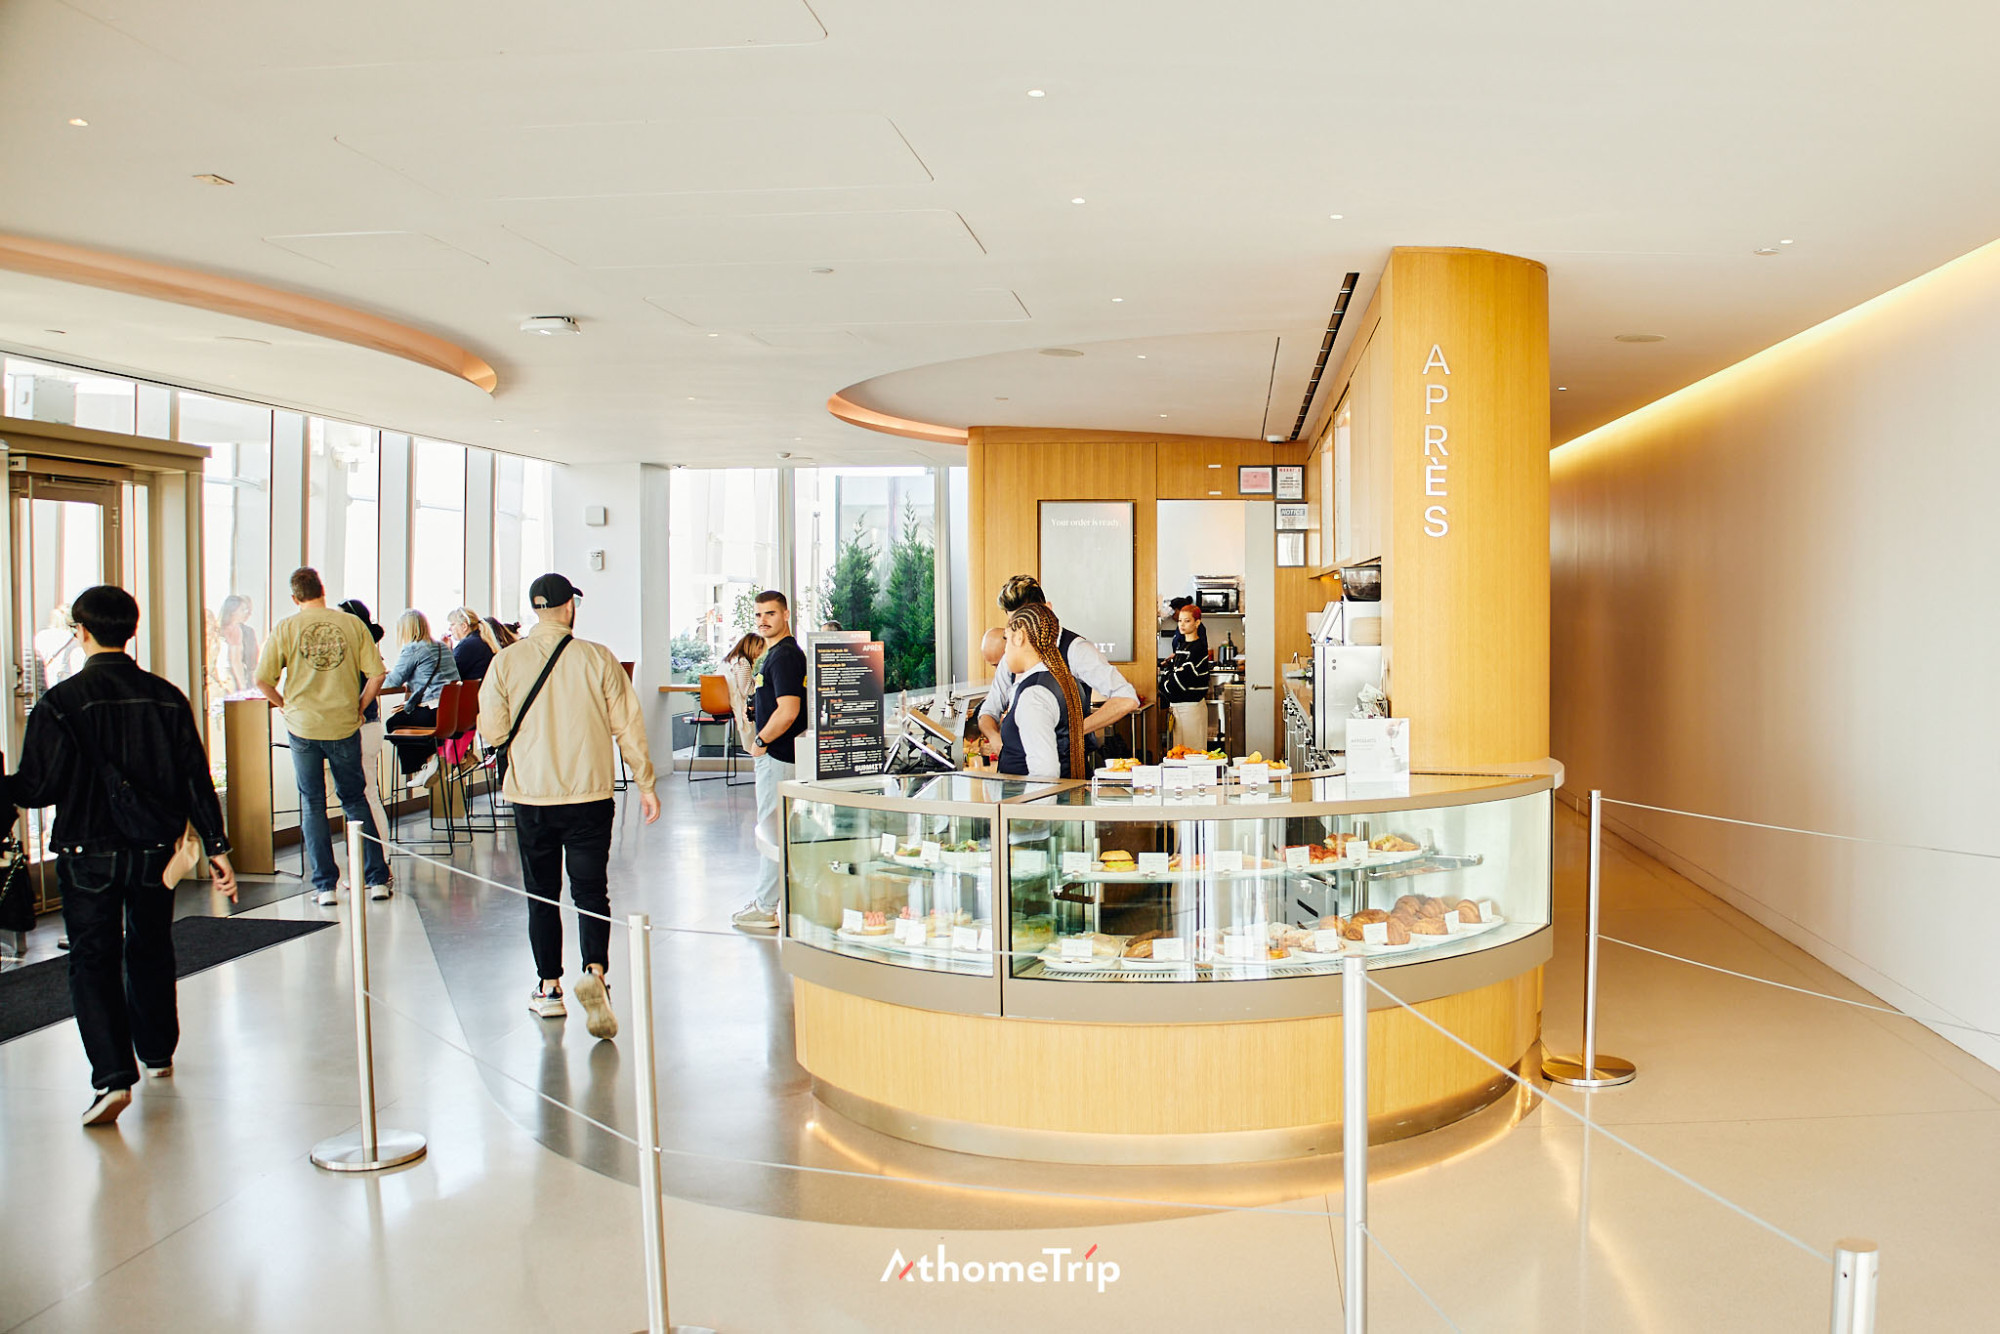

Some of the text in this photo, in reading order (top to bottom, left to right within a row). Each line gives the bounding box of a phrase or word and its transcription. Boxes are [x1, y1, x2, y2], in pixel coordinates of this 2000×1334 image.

[1422, 343, 1451, 538] APRÈS
[1051, 518, 1069, 526] Your
[1070, 518, 1090, 526] order
[862, 643, 882, 652] APRÈS
[854, 763, 883, 772] SUMMIT
